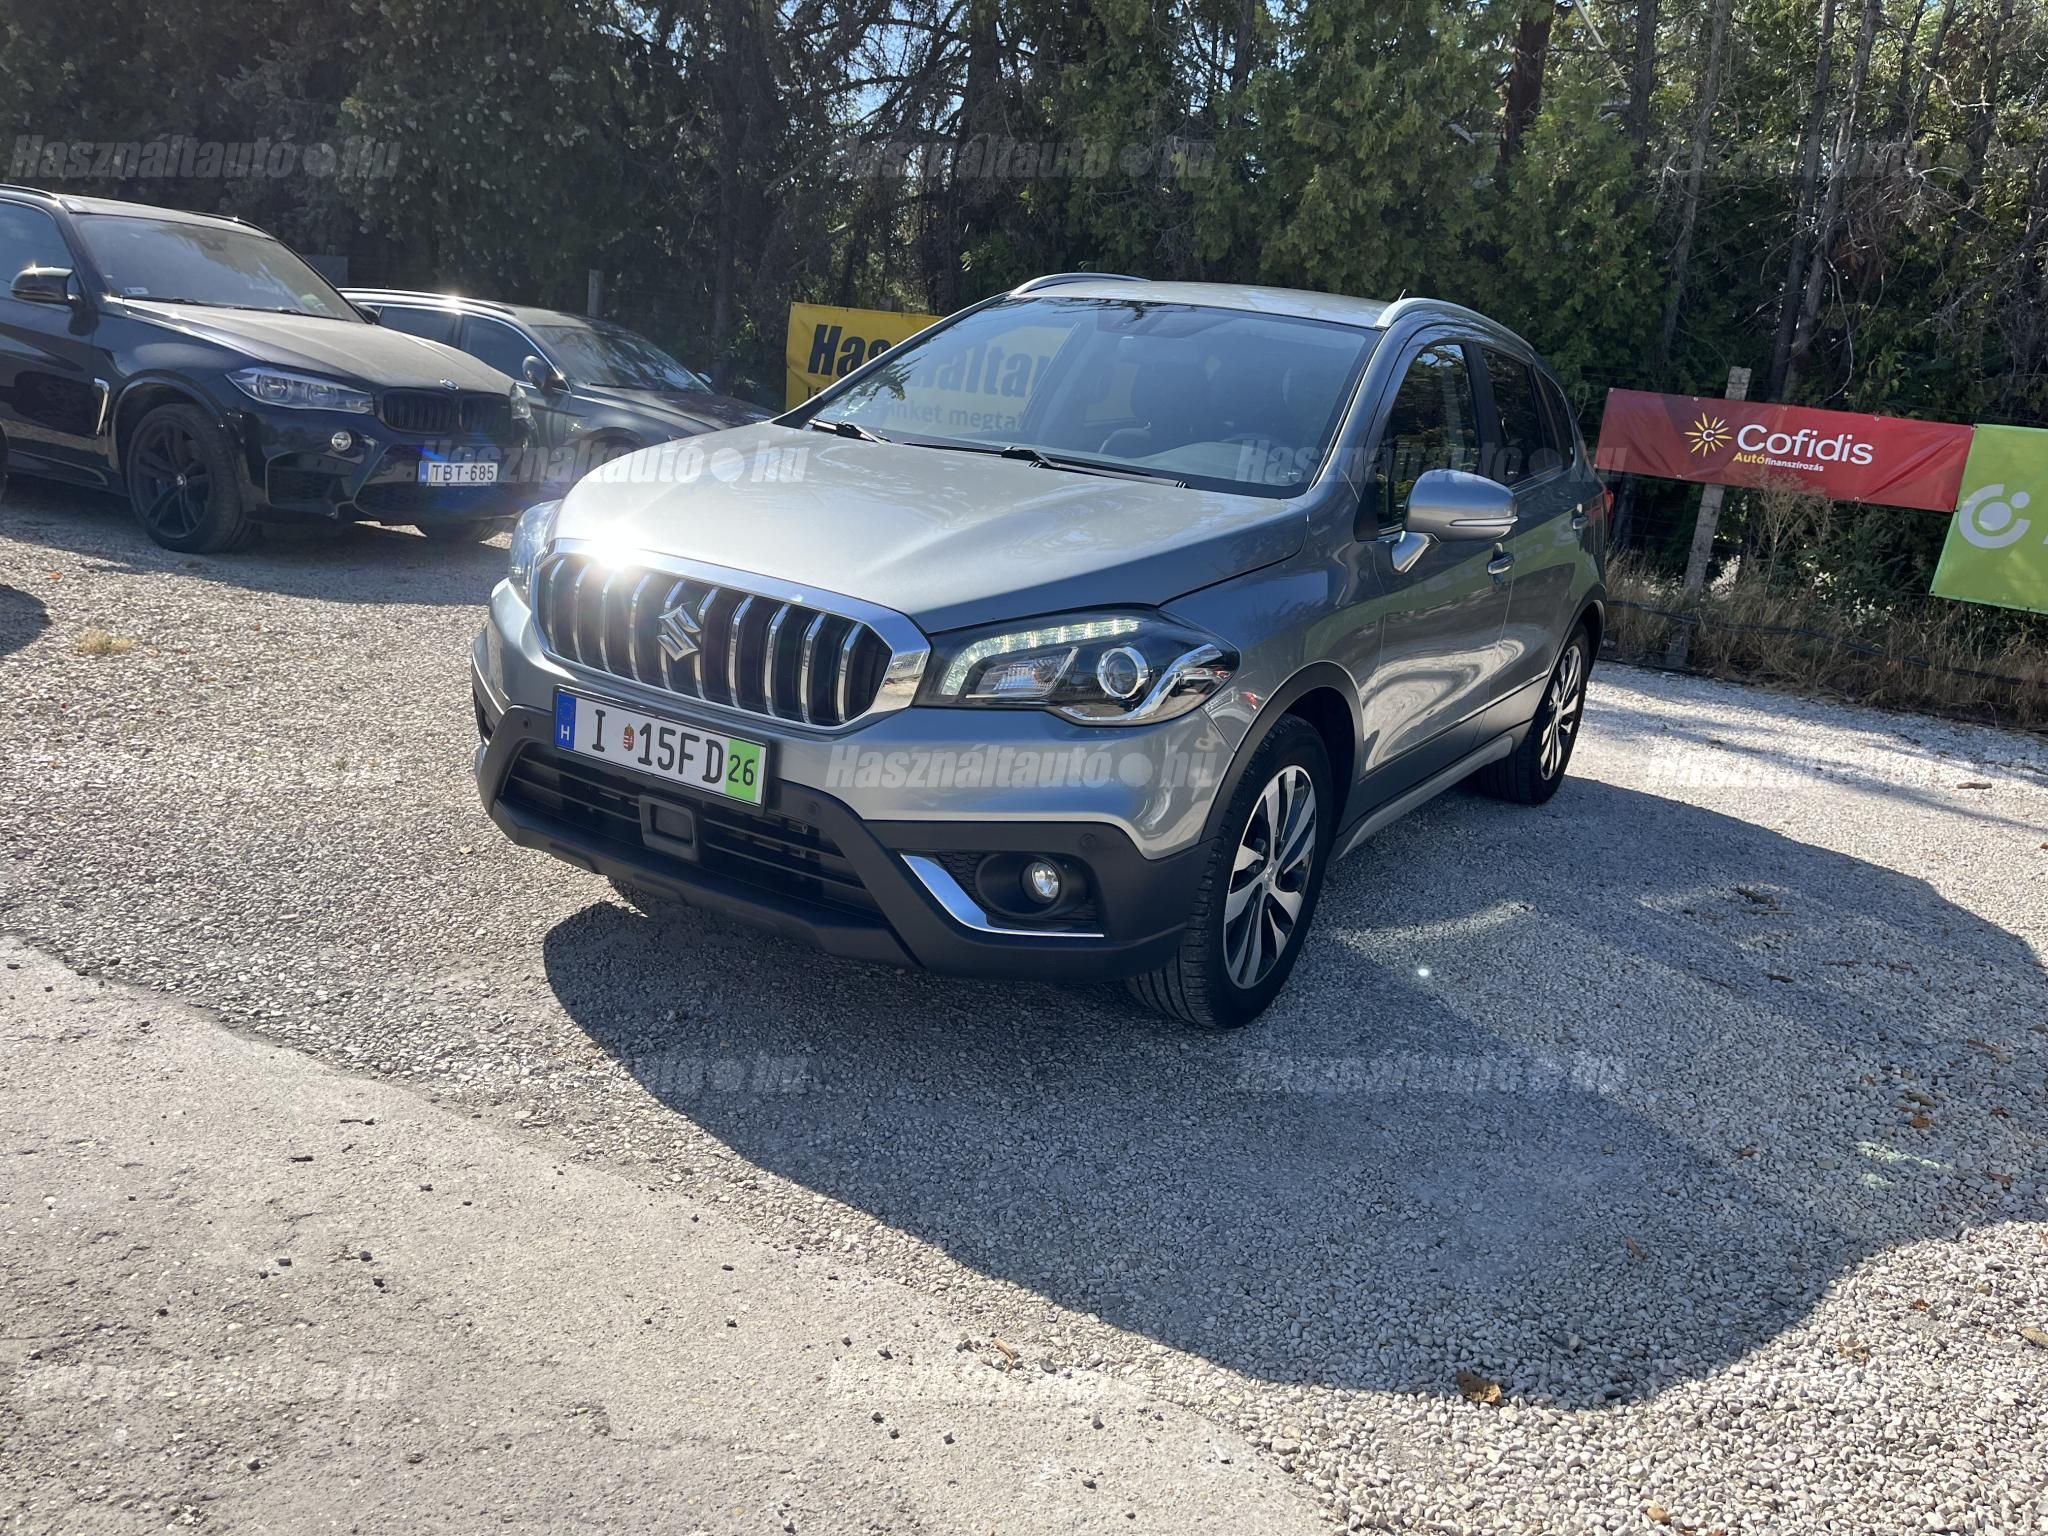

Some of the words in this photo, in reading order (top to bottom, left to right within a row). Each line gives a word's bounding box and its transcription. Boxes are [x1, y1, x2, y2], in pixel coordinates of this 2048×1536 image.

[1737, 423, 1875, 466] Cofidis
[432, 464, 494, 481] TBT-685
[560, 723, 571, 741] H
[727, 753, 755, 787] 26
